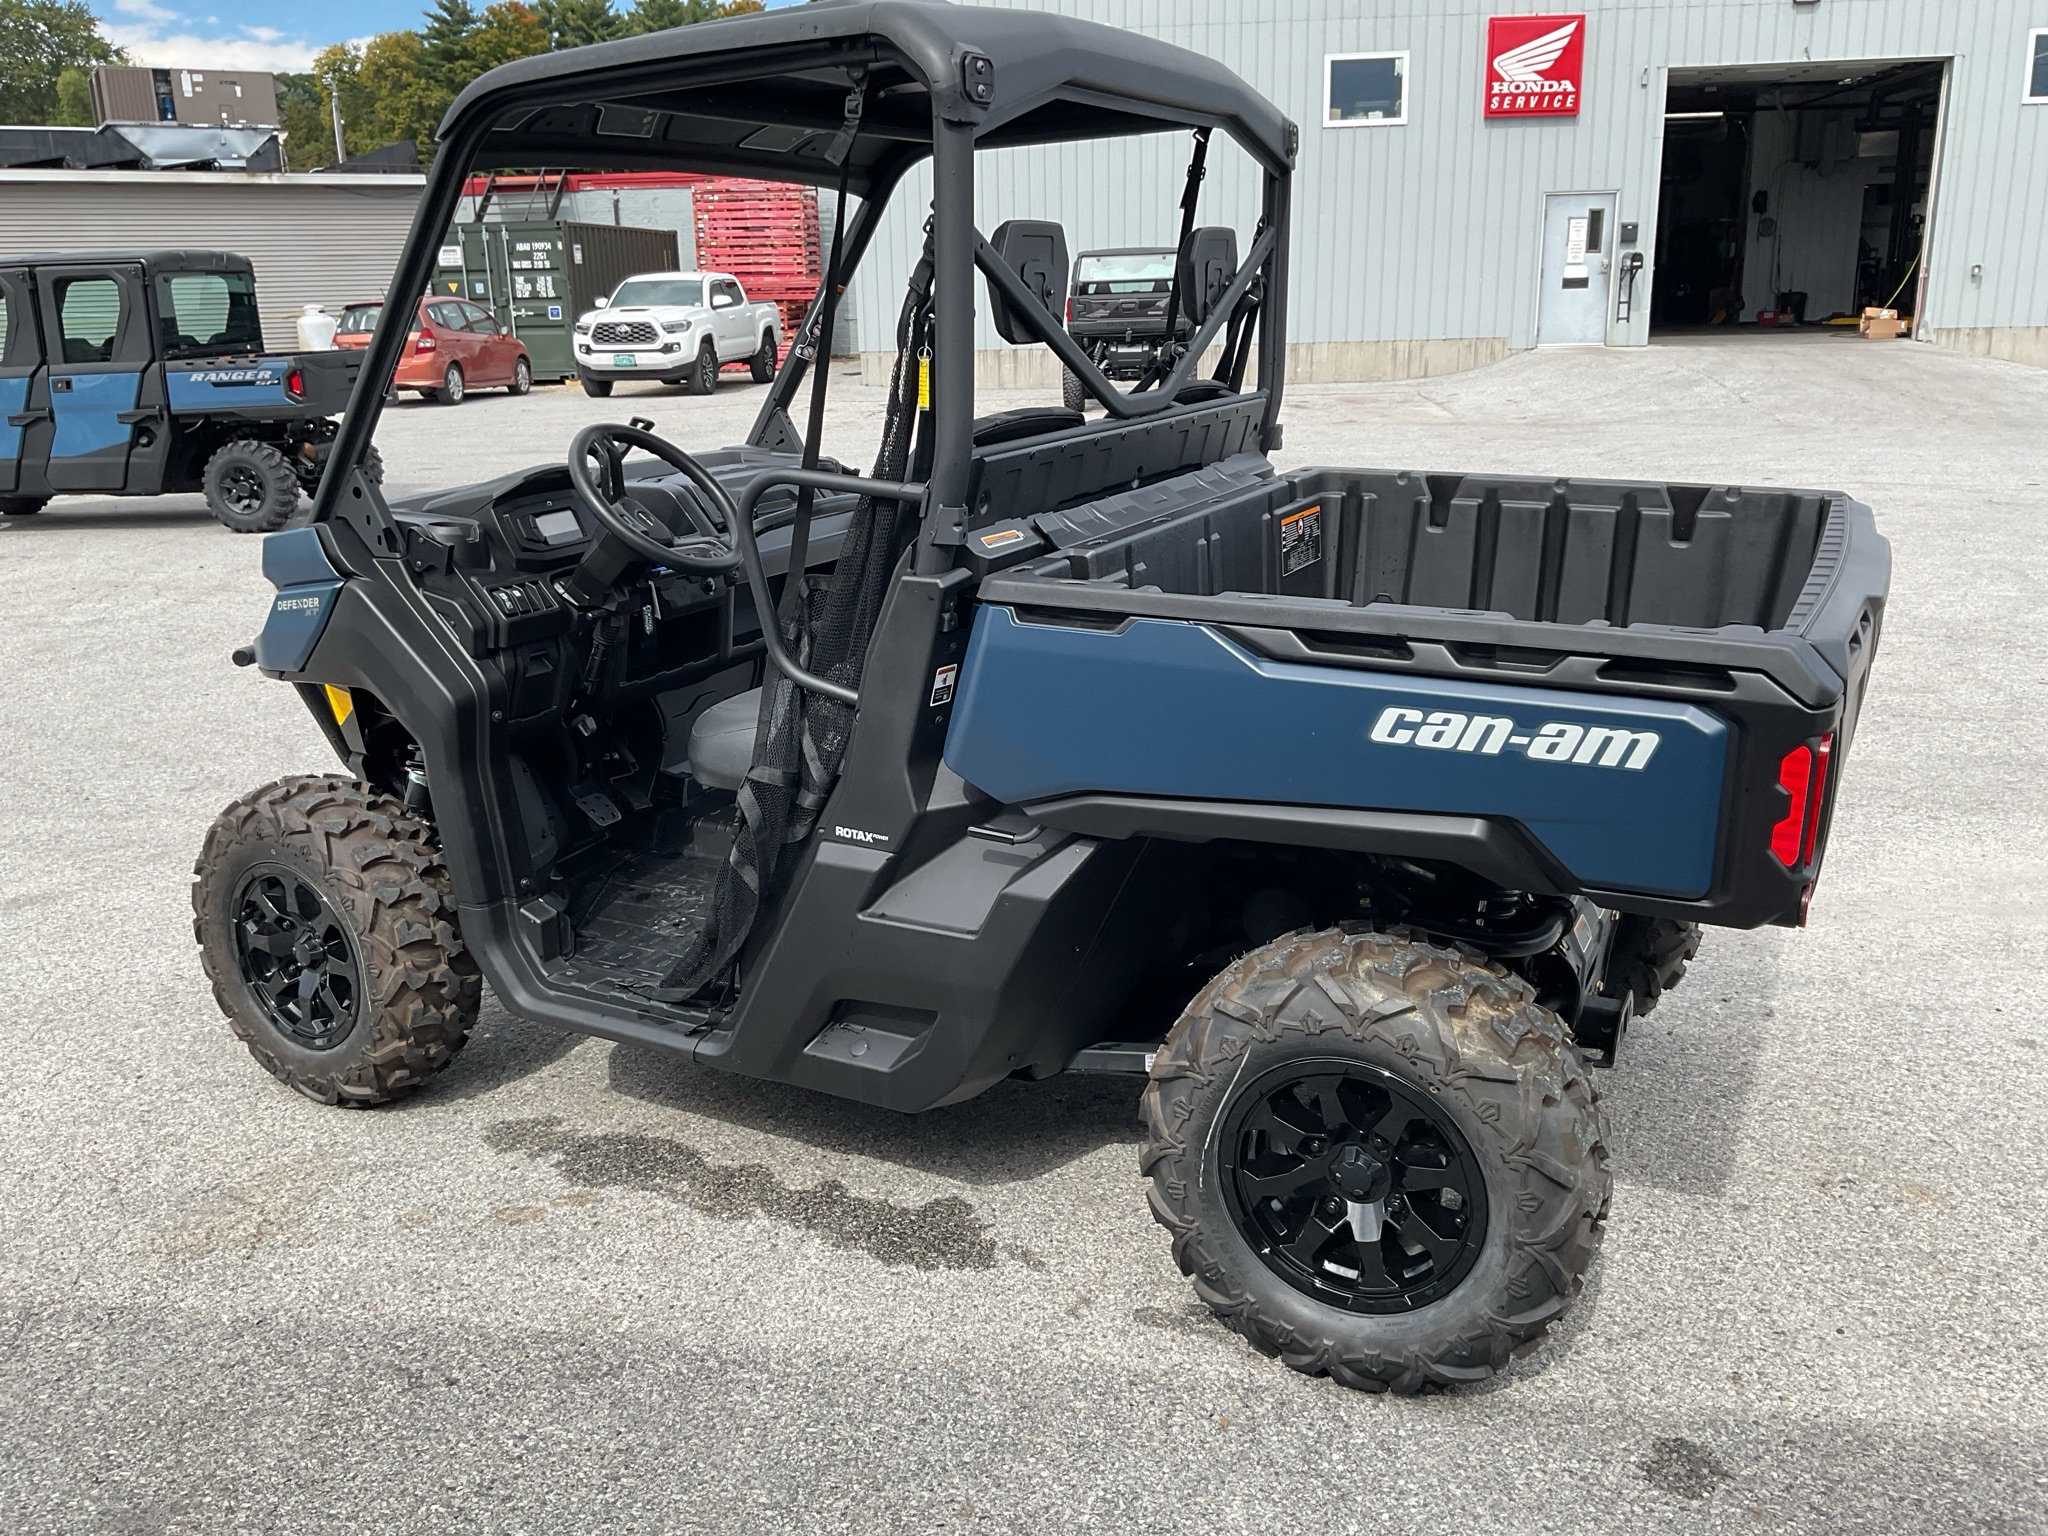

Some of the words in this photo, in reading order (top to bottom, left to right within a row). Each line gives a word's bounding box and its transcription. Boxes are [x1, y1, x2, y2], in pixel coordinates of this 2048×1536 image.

[1491, 80, 1576, 93] HONDA
[1490, 95, 1576, 109] SERVICE
[190, 370, 272, 382] RANGER
[277, 597, 319, 611] DEFENDER
[304, 608, 320, 617] XT
[1370, 707, 1660, 770] can-am
[835, 826, 873, 843] ROTAX
